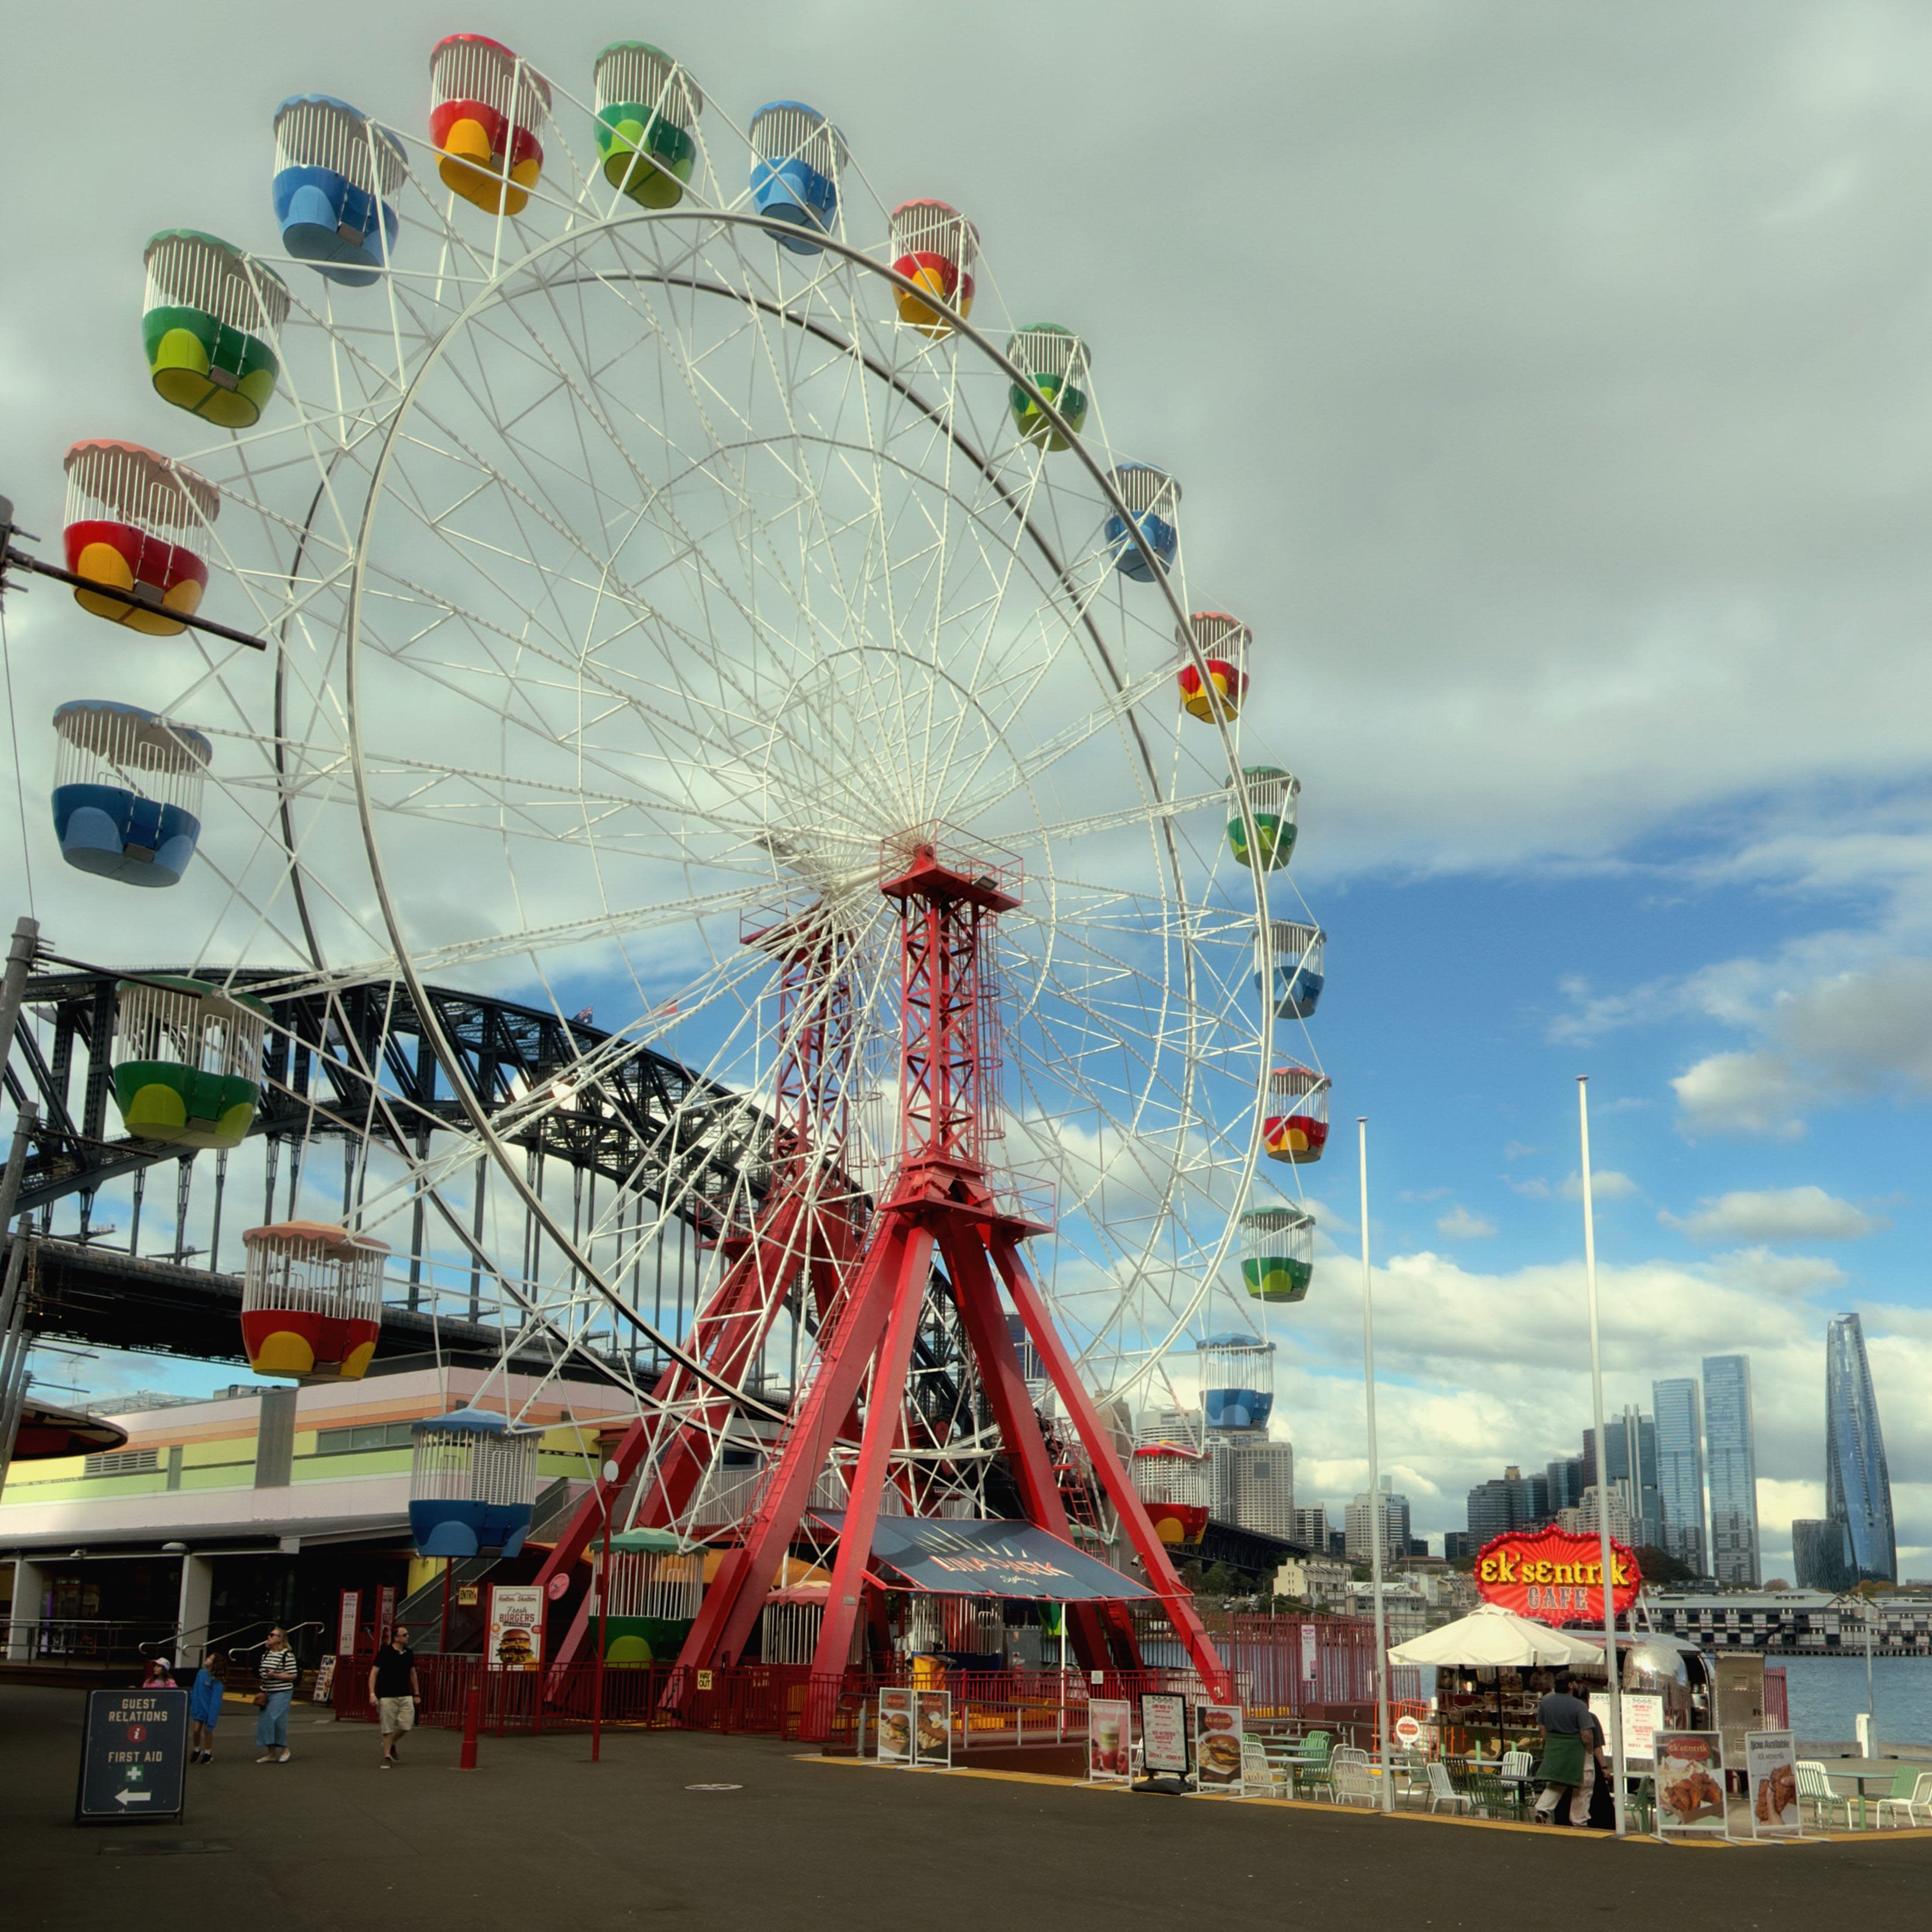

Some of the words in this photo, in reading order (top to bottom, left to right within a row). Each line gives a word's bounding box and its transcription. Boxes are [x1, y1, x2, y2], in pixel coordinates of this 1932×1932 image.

[929, 1555, 999, 1572] LUNA
[987, 1556, 1075, 1578] PARK
[460, 1589, 474, 1600] ENTRY
[1527, 1586, 1588, 1610] CAFE
[507, 1606, 527, 1614] Fresh
[499, 1613, 535, 1622] BURGERS
[122, 1698, 156, 1709] GUEST
[108, 1711, 168, 1722] RELATIONS
[1750, 1740, 1763, 1750] Now
[1765, 1739, 1790, 1749] Available
[108, 1751, 140, 1762] FIRST
[144, 1751, 163, 1762] AID
